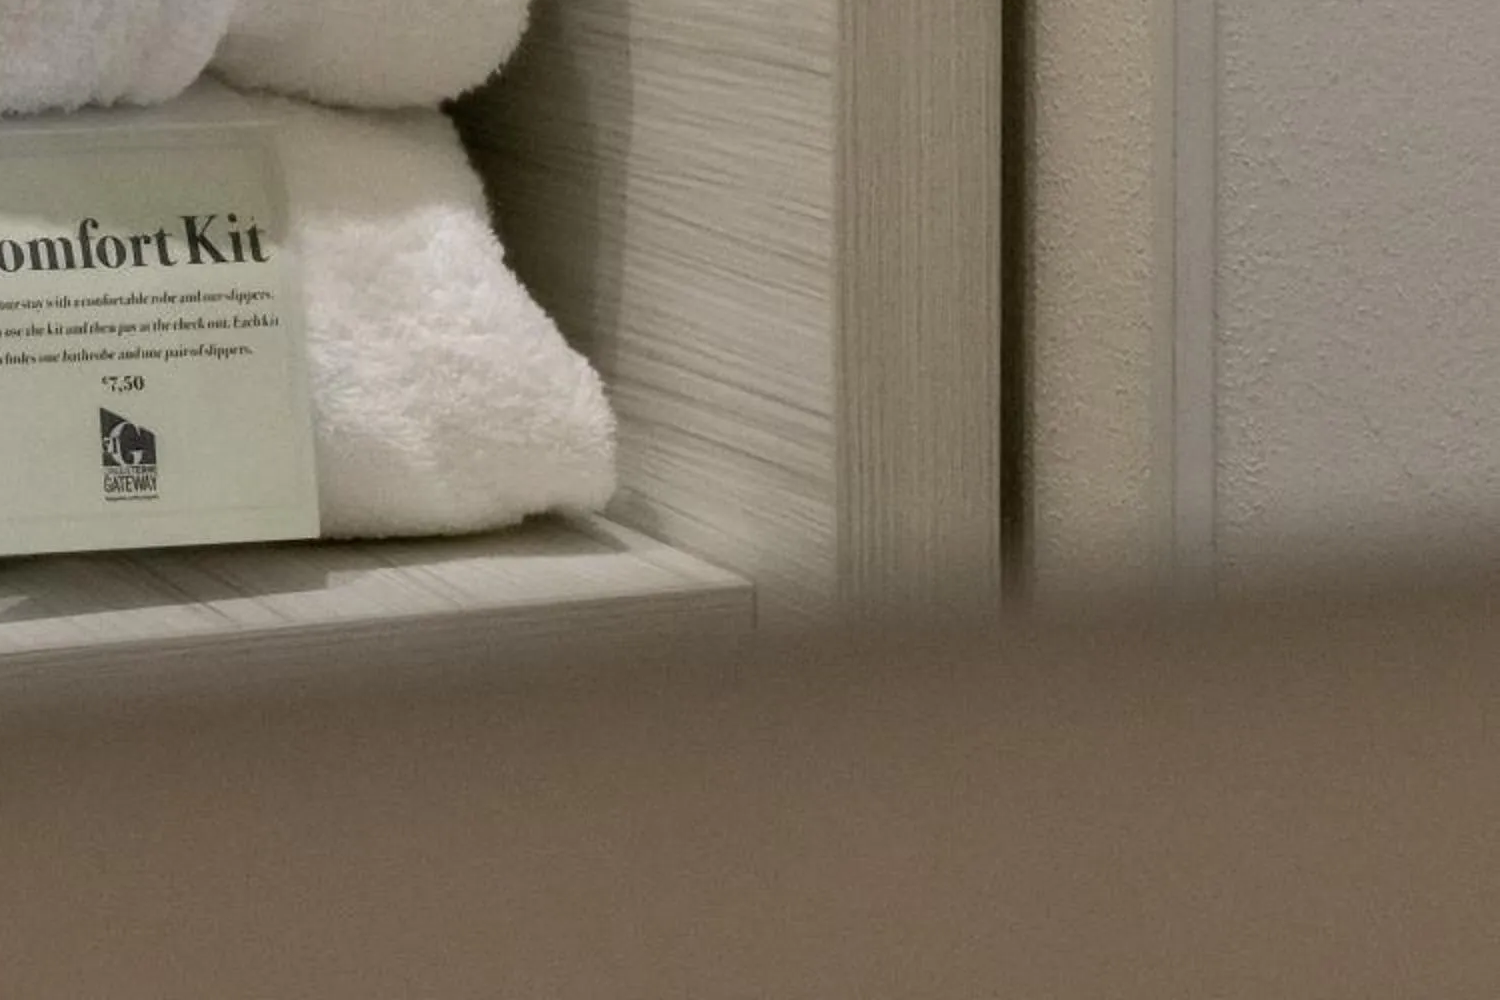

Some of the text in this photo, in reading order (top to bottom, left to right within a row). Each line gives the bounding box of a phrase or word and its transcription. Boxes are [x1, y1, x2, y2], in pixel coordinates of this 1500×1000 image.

[180, 212, 271, 265] Kit
[45, 295, 71, 309] with
[81, 291, 148, 307] comfortable
[151, 289, 177, 305] robe
[179, 289, 201, 304] and
[25, 322, 45, 337] the
[47, 320, 63, 335] kit
[65, 320, 88, 335] and
[152, 317, 170, 332] the
[172, 316, 205, 332] check
[233, 313, 262, 329] Each
[62, 347, 117, 363] bathrobe
[117, 346, 140, 361] and
[164, 344, 188, 363] pair
[189, 343, 204, 357] of
[104, 472, 157, 493] GATEWAY
